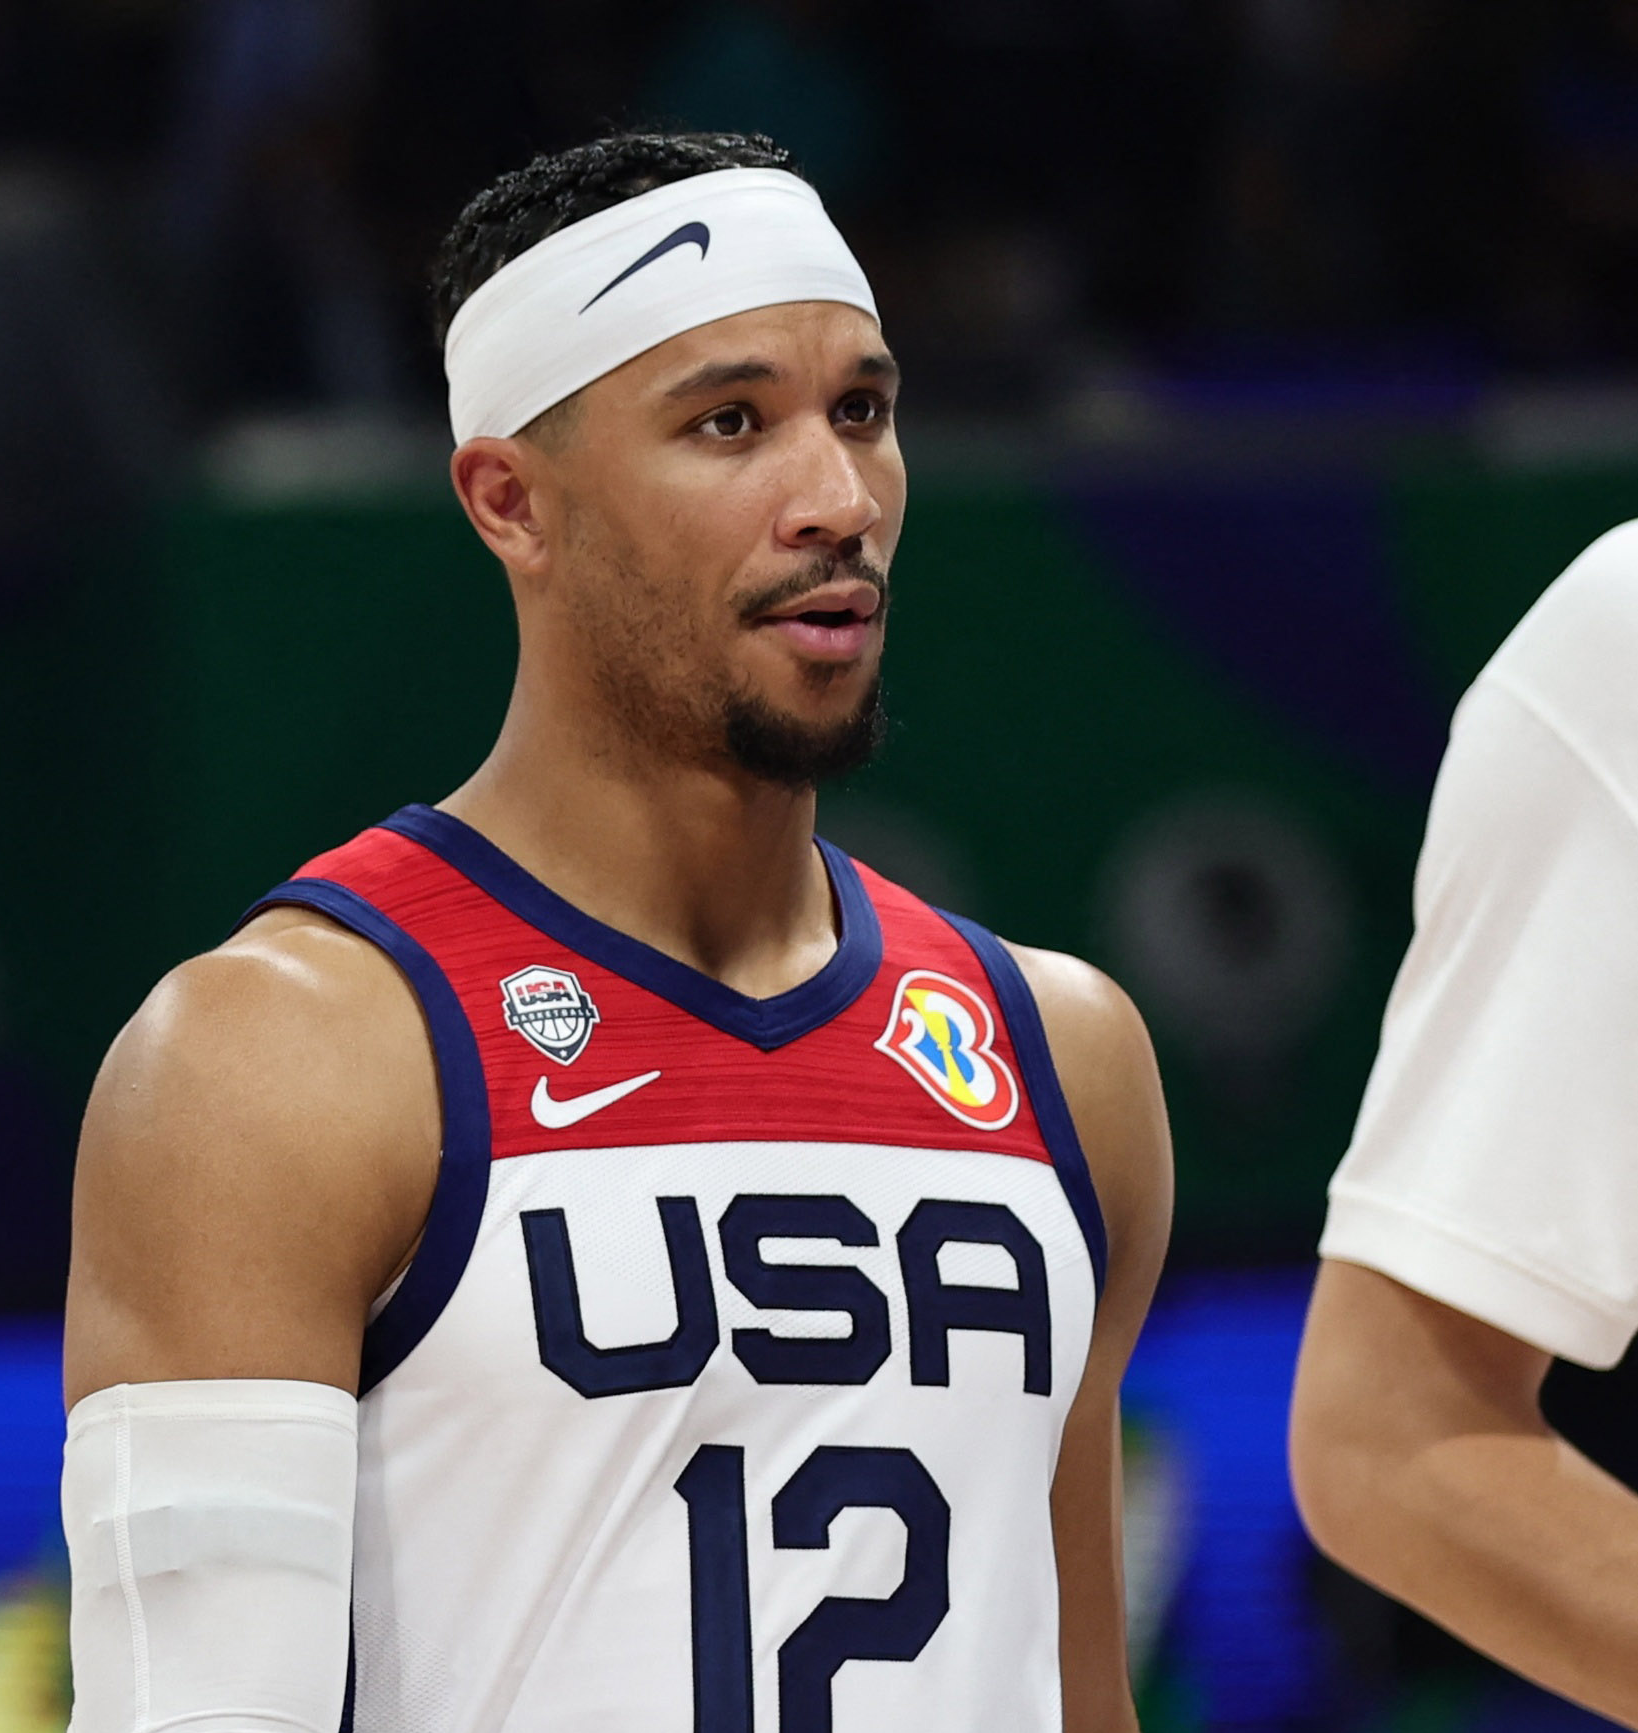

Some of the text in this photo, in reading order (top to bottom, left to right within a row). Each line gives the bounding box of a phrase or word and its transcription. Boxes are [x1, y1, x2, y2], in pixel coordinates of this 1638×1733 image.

[515, 981, 575, 1006] USA
[511, 1008, 592, 1024] BASKETBALL
[519, 1193, 1053, 1398] USA
